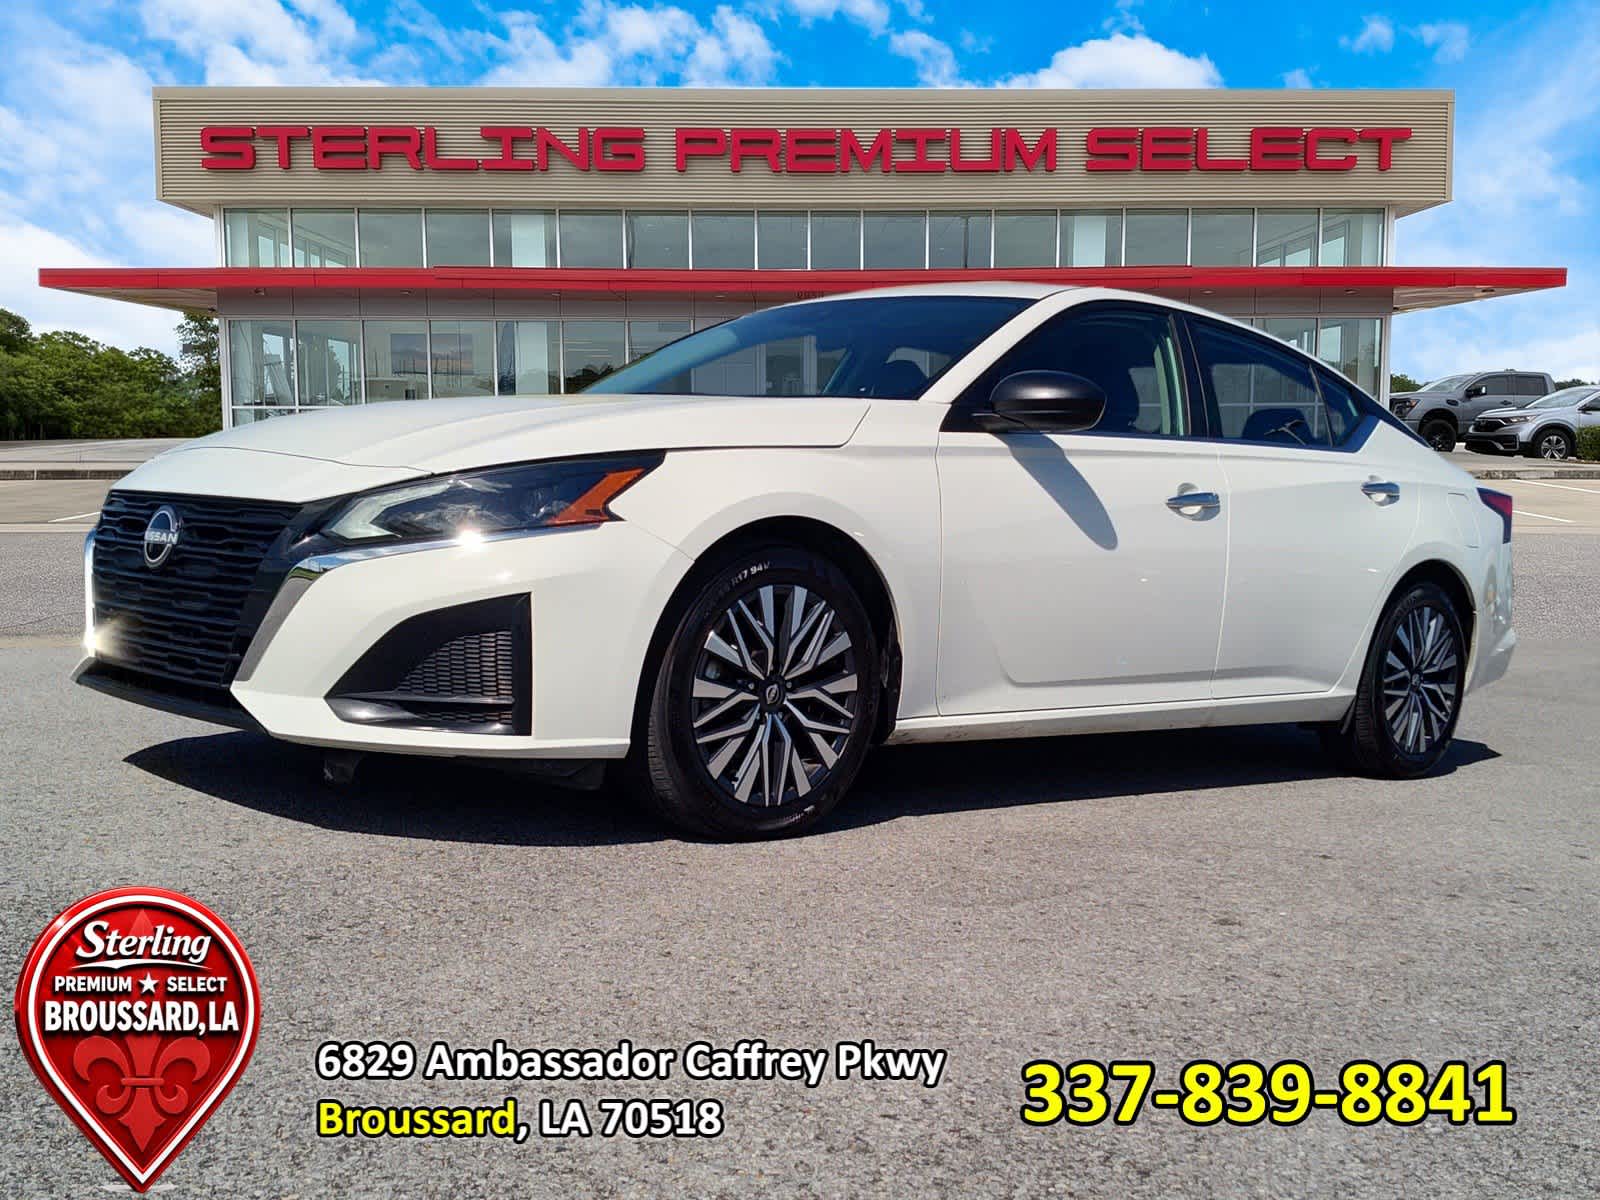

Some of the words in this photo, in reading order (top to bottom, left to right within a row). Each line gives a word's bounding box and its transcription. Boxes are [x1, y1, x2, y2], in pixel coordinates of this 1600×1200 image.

[200, 126, 646, 173] STERLING
[675, 127, 1058, 173] PREMIUM
[1086, 127, 1413, 172] SELECT
